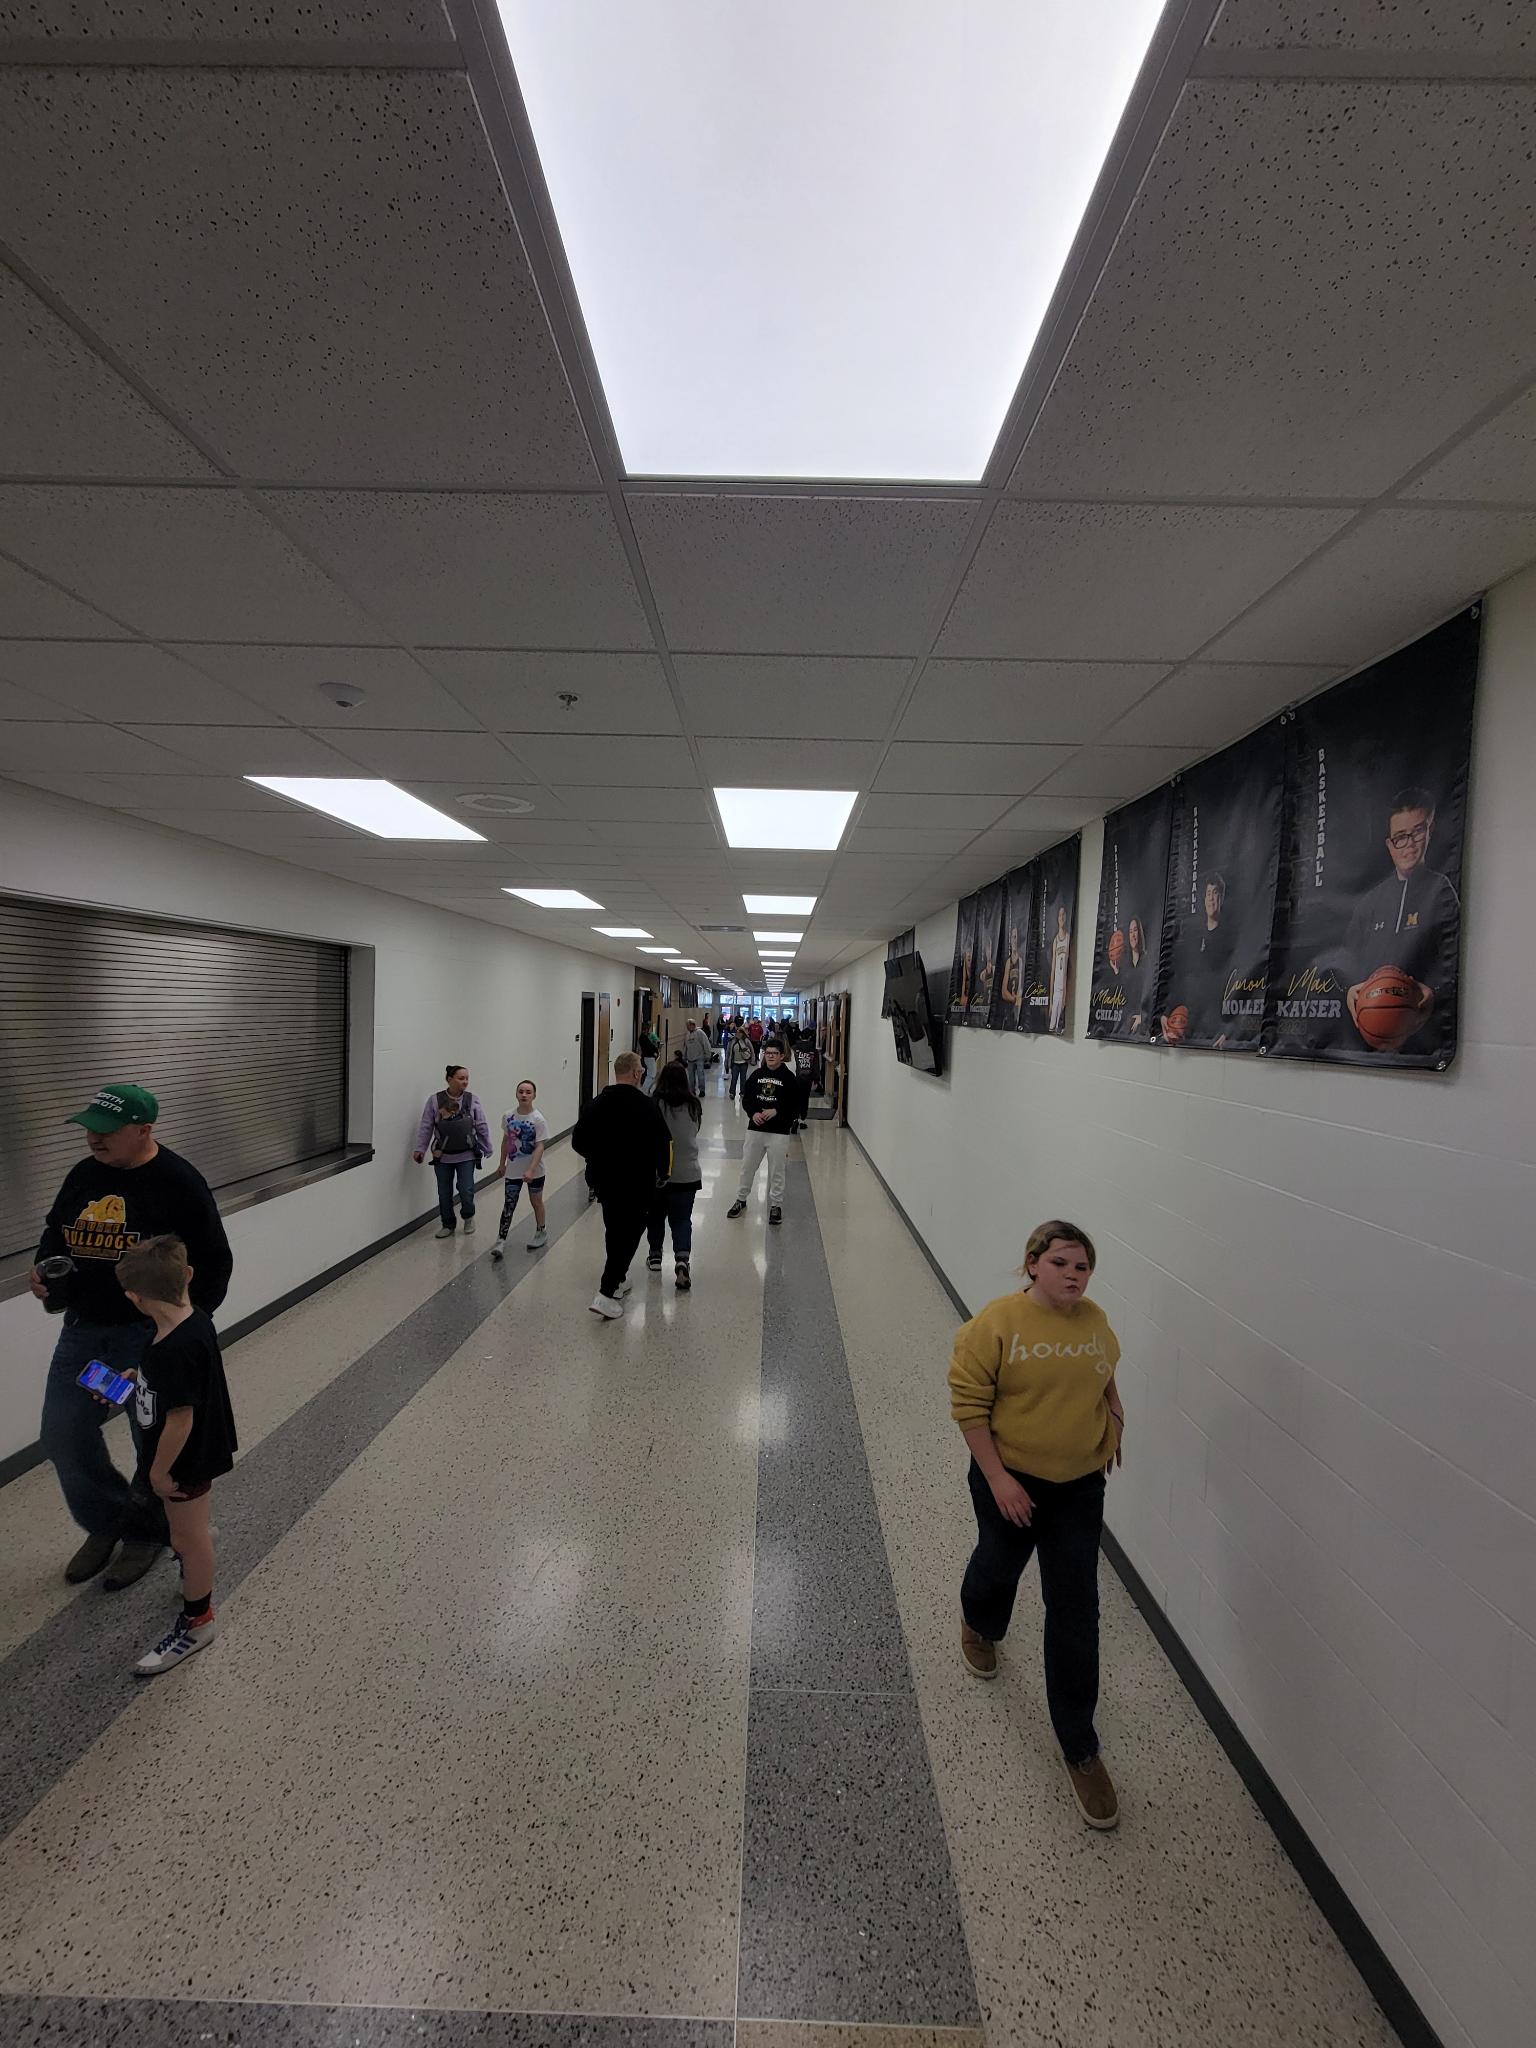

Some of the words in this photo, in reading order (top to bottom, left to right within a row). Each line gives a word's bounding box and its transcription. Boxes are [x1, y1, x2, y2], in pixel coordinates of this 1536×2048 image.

[1315, 748, 1326, 887] BASKETBALL
[1191, 806, 1199, 914] BASKETBALL
[1287, 966, 1337, 1000] Max
[1095, 1009, 1123, 1022] CHILDS
[1275, 1000, 1342, 1018] KAYSER
[1007, 1332, 1113, 1377] howdy
